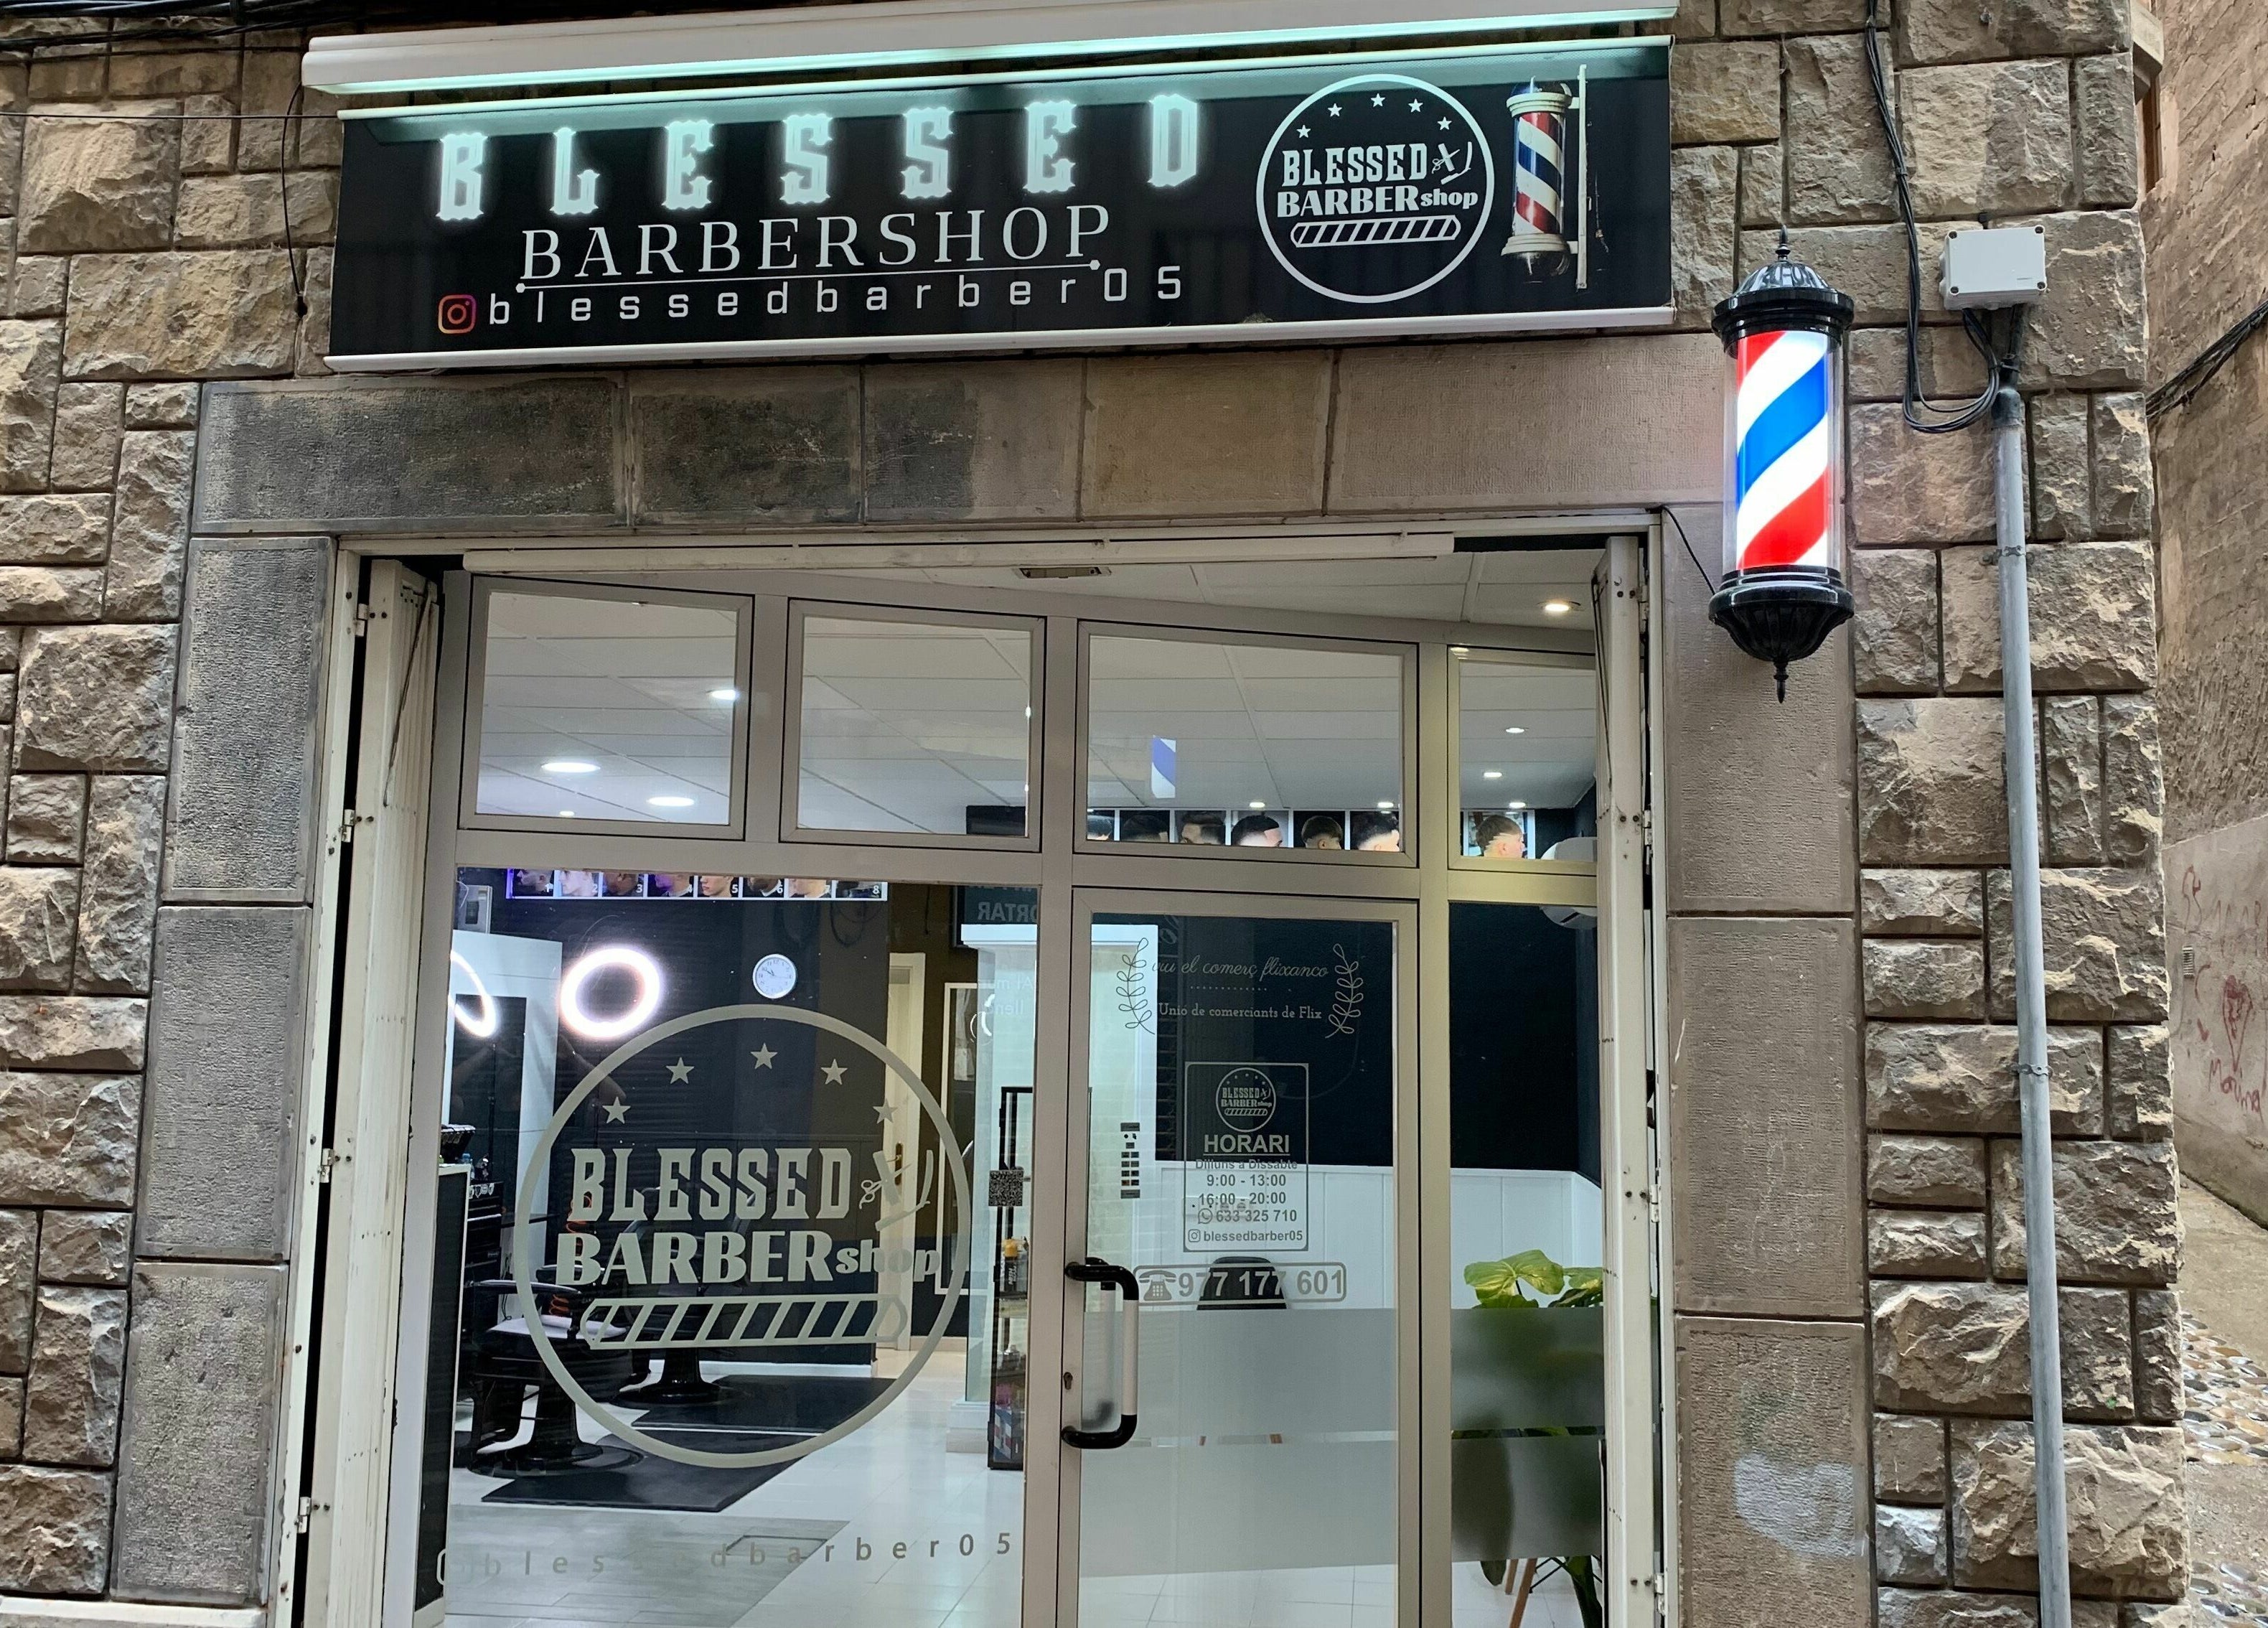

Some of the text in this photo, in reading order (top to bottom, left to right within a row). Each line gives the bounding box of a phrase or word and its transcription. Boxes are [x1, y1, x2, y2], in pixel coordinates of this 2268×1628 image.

[435, 93, 1199, 221] BLESSED
[1281, 142, 1428, 187] BLESSED
[519, 204, 1110, 280] BARBERSHOP
[489, 266, 1181, 325] blessedbarber05
[1181, 954, 1201, 973] el
[1203, 962, 1257, 978] comerç
[1191, 1002, 1205, 1016] de
[1209, 1006, 1278, 1018] comerciants
[1282, 1005, 1295, 1018] de
[1299, 1006, 1322, 1019] Flix
[1222, 1087, 1260, 1098] BLESSED
[1204, 1134, 1290, 1153] HORARI
[1196, 1159, 1298, 1169] Dilluns a Dissabte
[567, 1147, 852, 1222] BLESSED
[1206, 1174, 1236, 1187] 9:00
[1250, 1174, 1286, 1187] 13:00
[1199, 1193, 1236, 1206] 16:00
[1249, 1192, 1286, 1204] 20:00
[1216, 1209, 1298, 1222] 633 325 710
[1204, 1230, 1303, 1242] blessedbarber05
[1178, 1269, 1342, 1297] 977 177 601
[484, 1532, 1011, 1576] blesdbarber05
